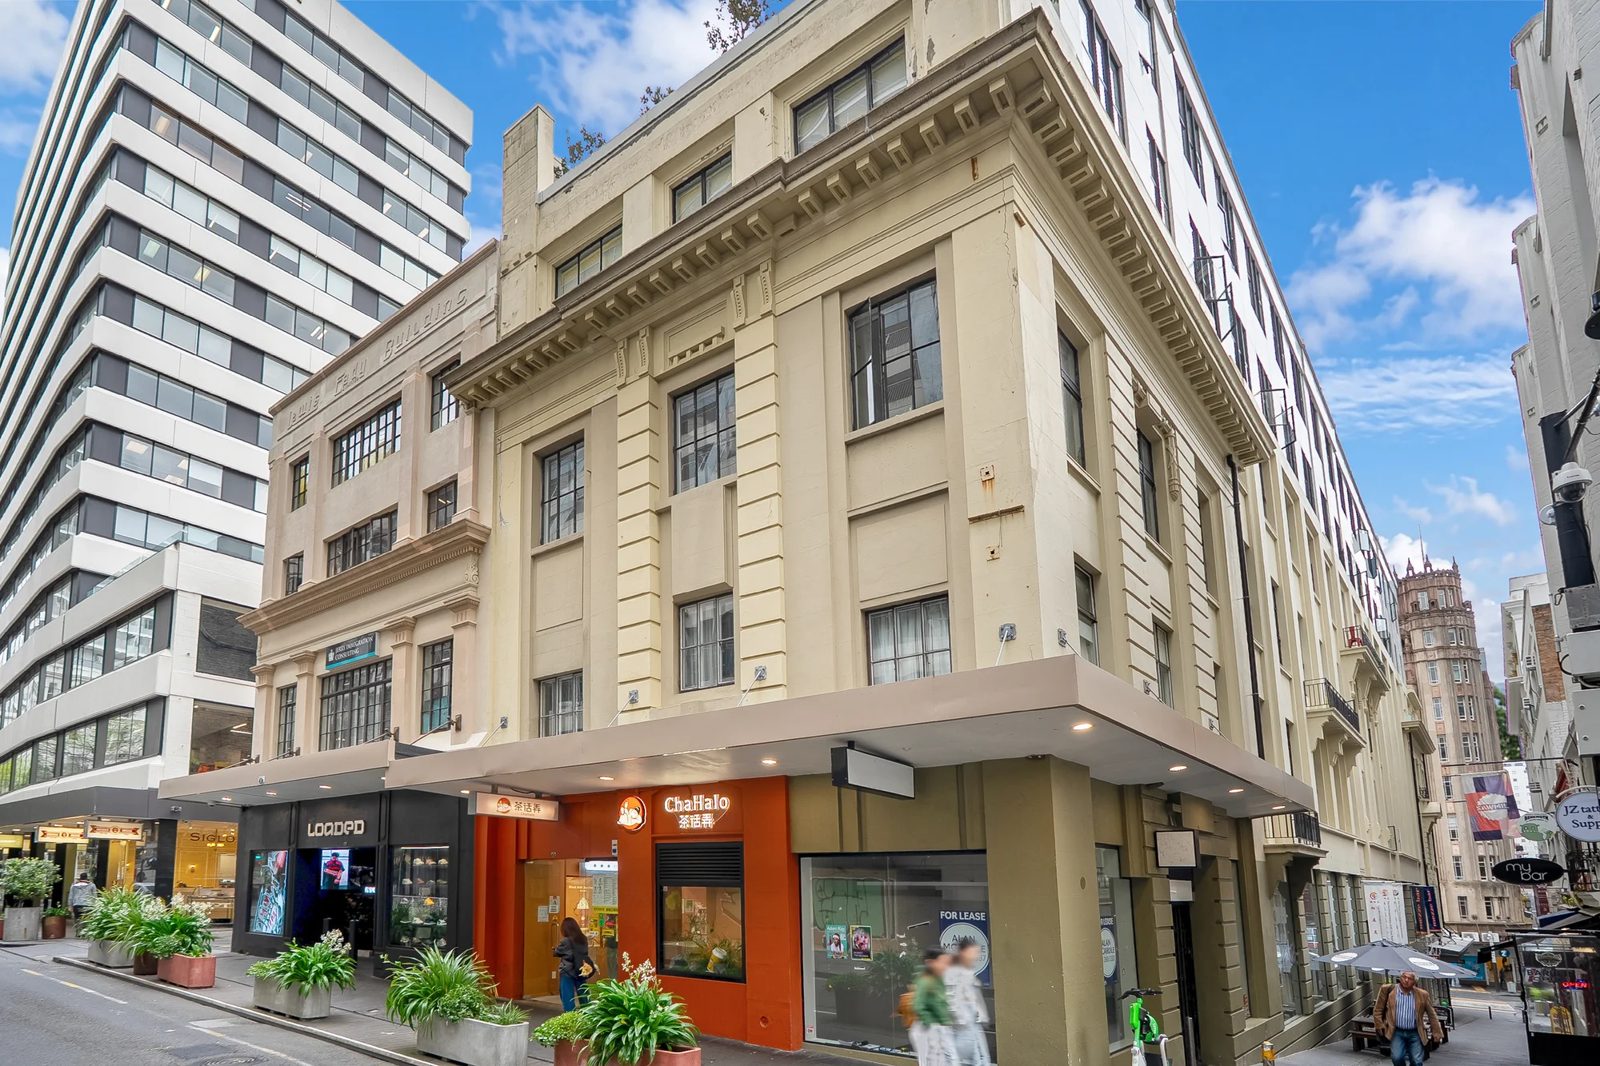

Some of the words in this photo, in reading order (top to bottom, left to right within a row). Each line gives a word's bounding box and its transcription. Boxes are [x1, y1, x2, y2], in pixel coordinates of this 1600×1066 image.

[664, 794, 729, 813] ChaHalo
[1563, 805, 1579, 816] JZ
[190, 832, 235, 843] SIGLO
[1505, 863, 1531, 872] my
[1520, 870, 1548, 881] bar
[940, 911, 958, 920] FOR
[960, 911, 986, 921] LEASE
